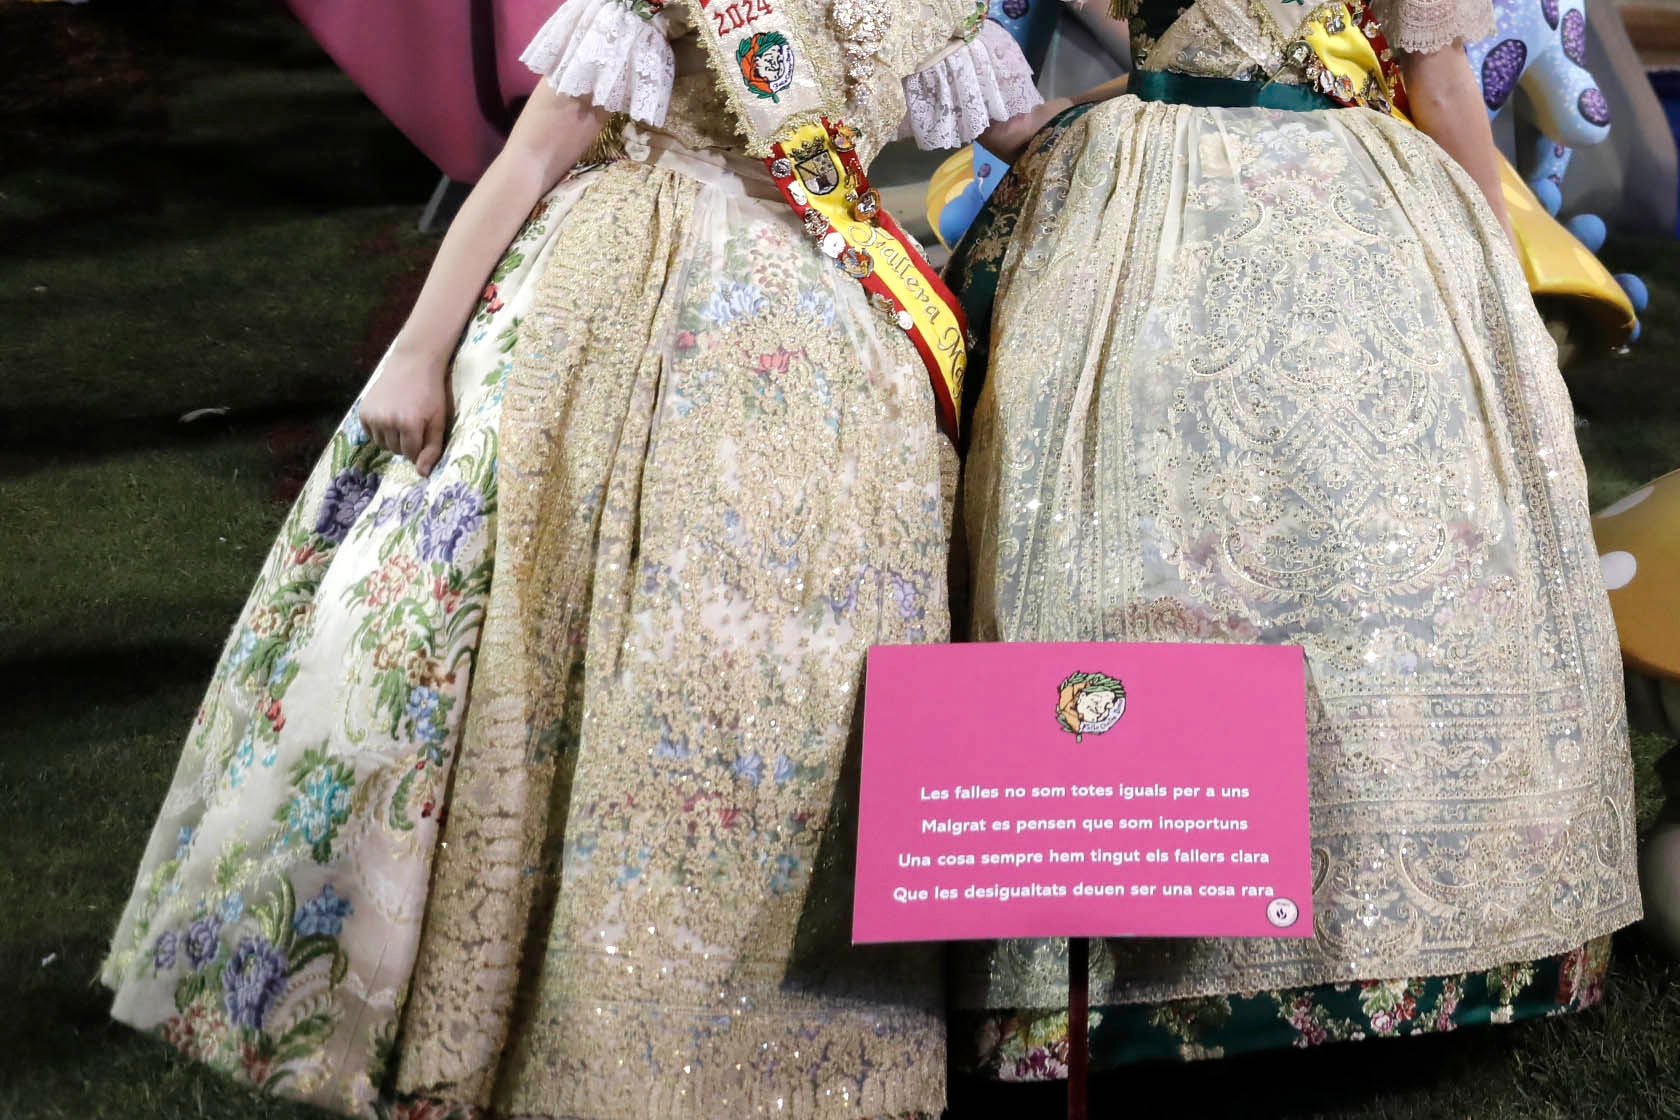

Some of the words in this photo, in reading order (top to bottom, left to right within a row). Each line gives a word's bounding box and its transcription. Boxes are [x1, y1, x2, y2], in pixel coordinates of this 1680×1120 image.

[920, 786, 950, 801] Les
[954, 784, 1000, 800] falles
[1004, 787, 1027, 798] no
[1031, 786, 1066, 798] som
[1070, 783, 1114, 797] totes
[1119, 783, 1168, 801] iguals
[1172, 786, 1201, 801] per
[1205, 786, 1216, 798] a
[1221, 787, 1250, 799] uns
[921, 818, 987, 836] Malgrat
[991, 820, 1011, 832] es
[1016, 818, 1077, 835] pensen
[1081, 818, 1114, 833] que
[1118, 818, 1153, 830] som
[1158, 815, 1249, 833] inoportuns
[898, 852, 932, 868] Una
[936, 854, 976, 867] cosa
[980, 852, 1044, 868] sempre
[1049, 848, 1085, 863] hem
[1089, 848, 1141, 867] tingut
[1145, 847, 1170, 863] els
[1173, 848, 1226, 864] fallers
[1230, 848, 1270, 865] clara
[892, 886, 929, 904] Que
[934, 885, 959, 901] les
[963, 882, 1067, 902] desigualtats
[1071, 881, 1125, 897] deuen
[1129, 884, 1157, 897] ser
[1162, 884, 1193, 897] una
[1198, 885, 1236, 897] cosa
[1241, 885, 1274, 897] rara
